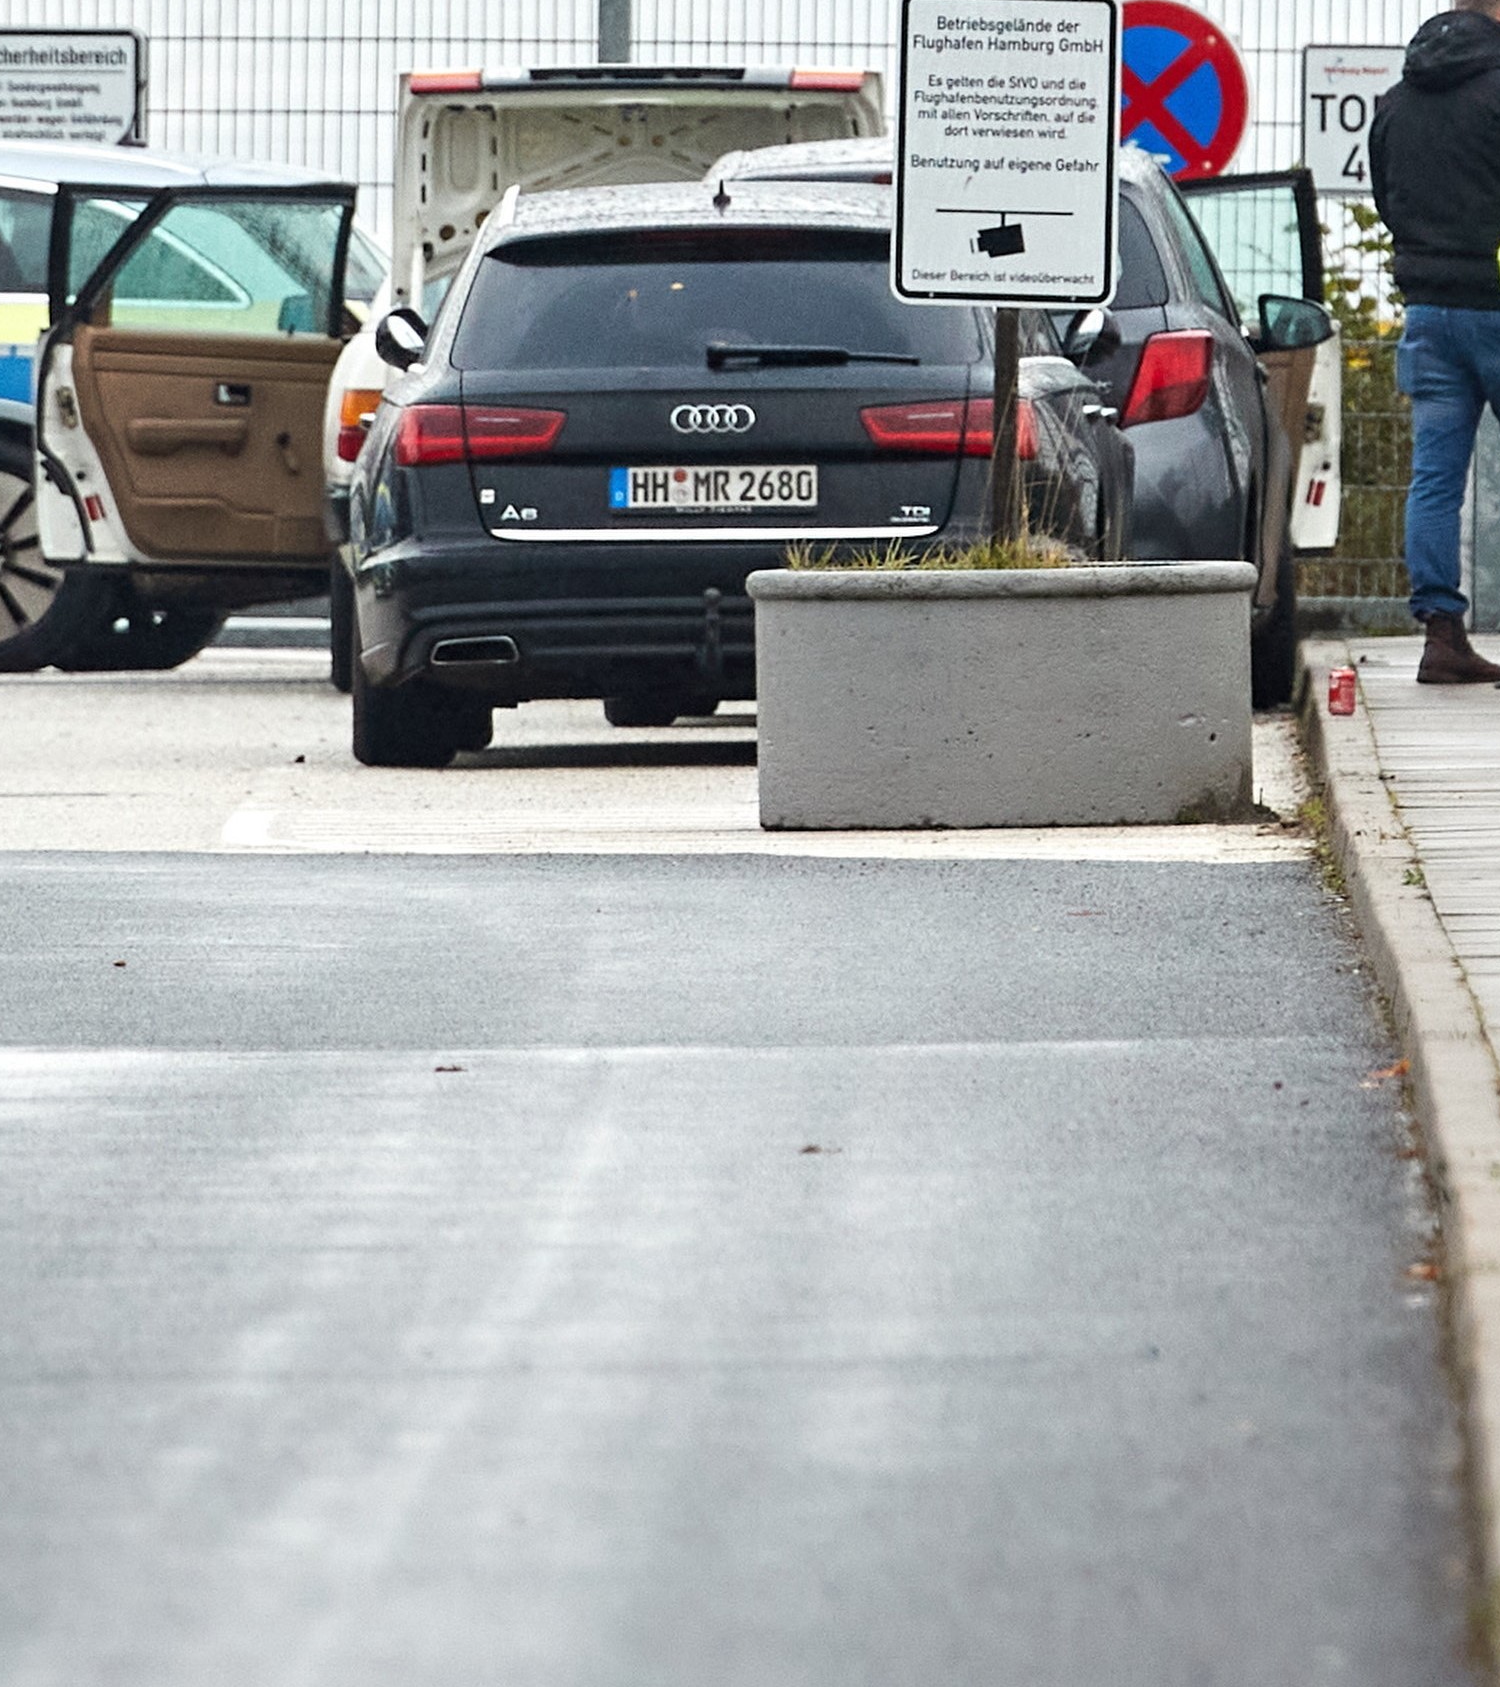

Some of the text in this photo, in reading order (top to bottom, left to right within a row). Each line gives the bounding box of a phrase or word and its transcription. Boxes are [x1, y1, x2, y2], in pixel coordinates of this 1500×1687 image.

[937, 16, 1080, 34] Betriebsgelände der
[913, 35, 1103, 55] Flughafen Hamburg GmbH
[929, 75, 1086, 90] Es gelten die StVO und die
[918, 109, 937, 119] mit
[941, 109, 970, 120] allen
[1054, 112, 1073, 122] auf
[1077, 112, 1095, 123] die
[944, 125, 968, 136] dort
[971, 127, 1033, 137] verwiesen
[911, 154, 1099, 173] Benutzung auf eigene Gefahr
[1342, 145, 1366, 182] 4
[912, 269, 1094, 284] Dieser Bereich ist videoüberwacht
[633, 472, 668, 502] HH
[694, 471, 729, 501] MR
[739, 471, 812, 501] 2680
[501, 505, 537, 521] A6
[901, 506, 931, 516] TDI
